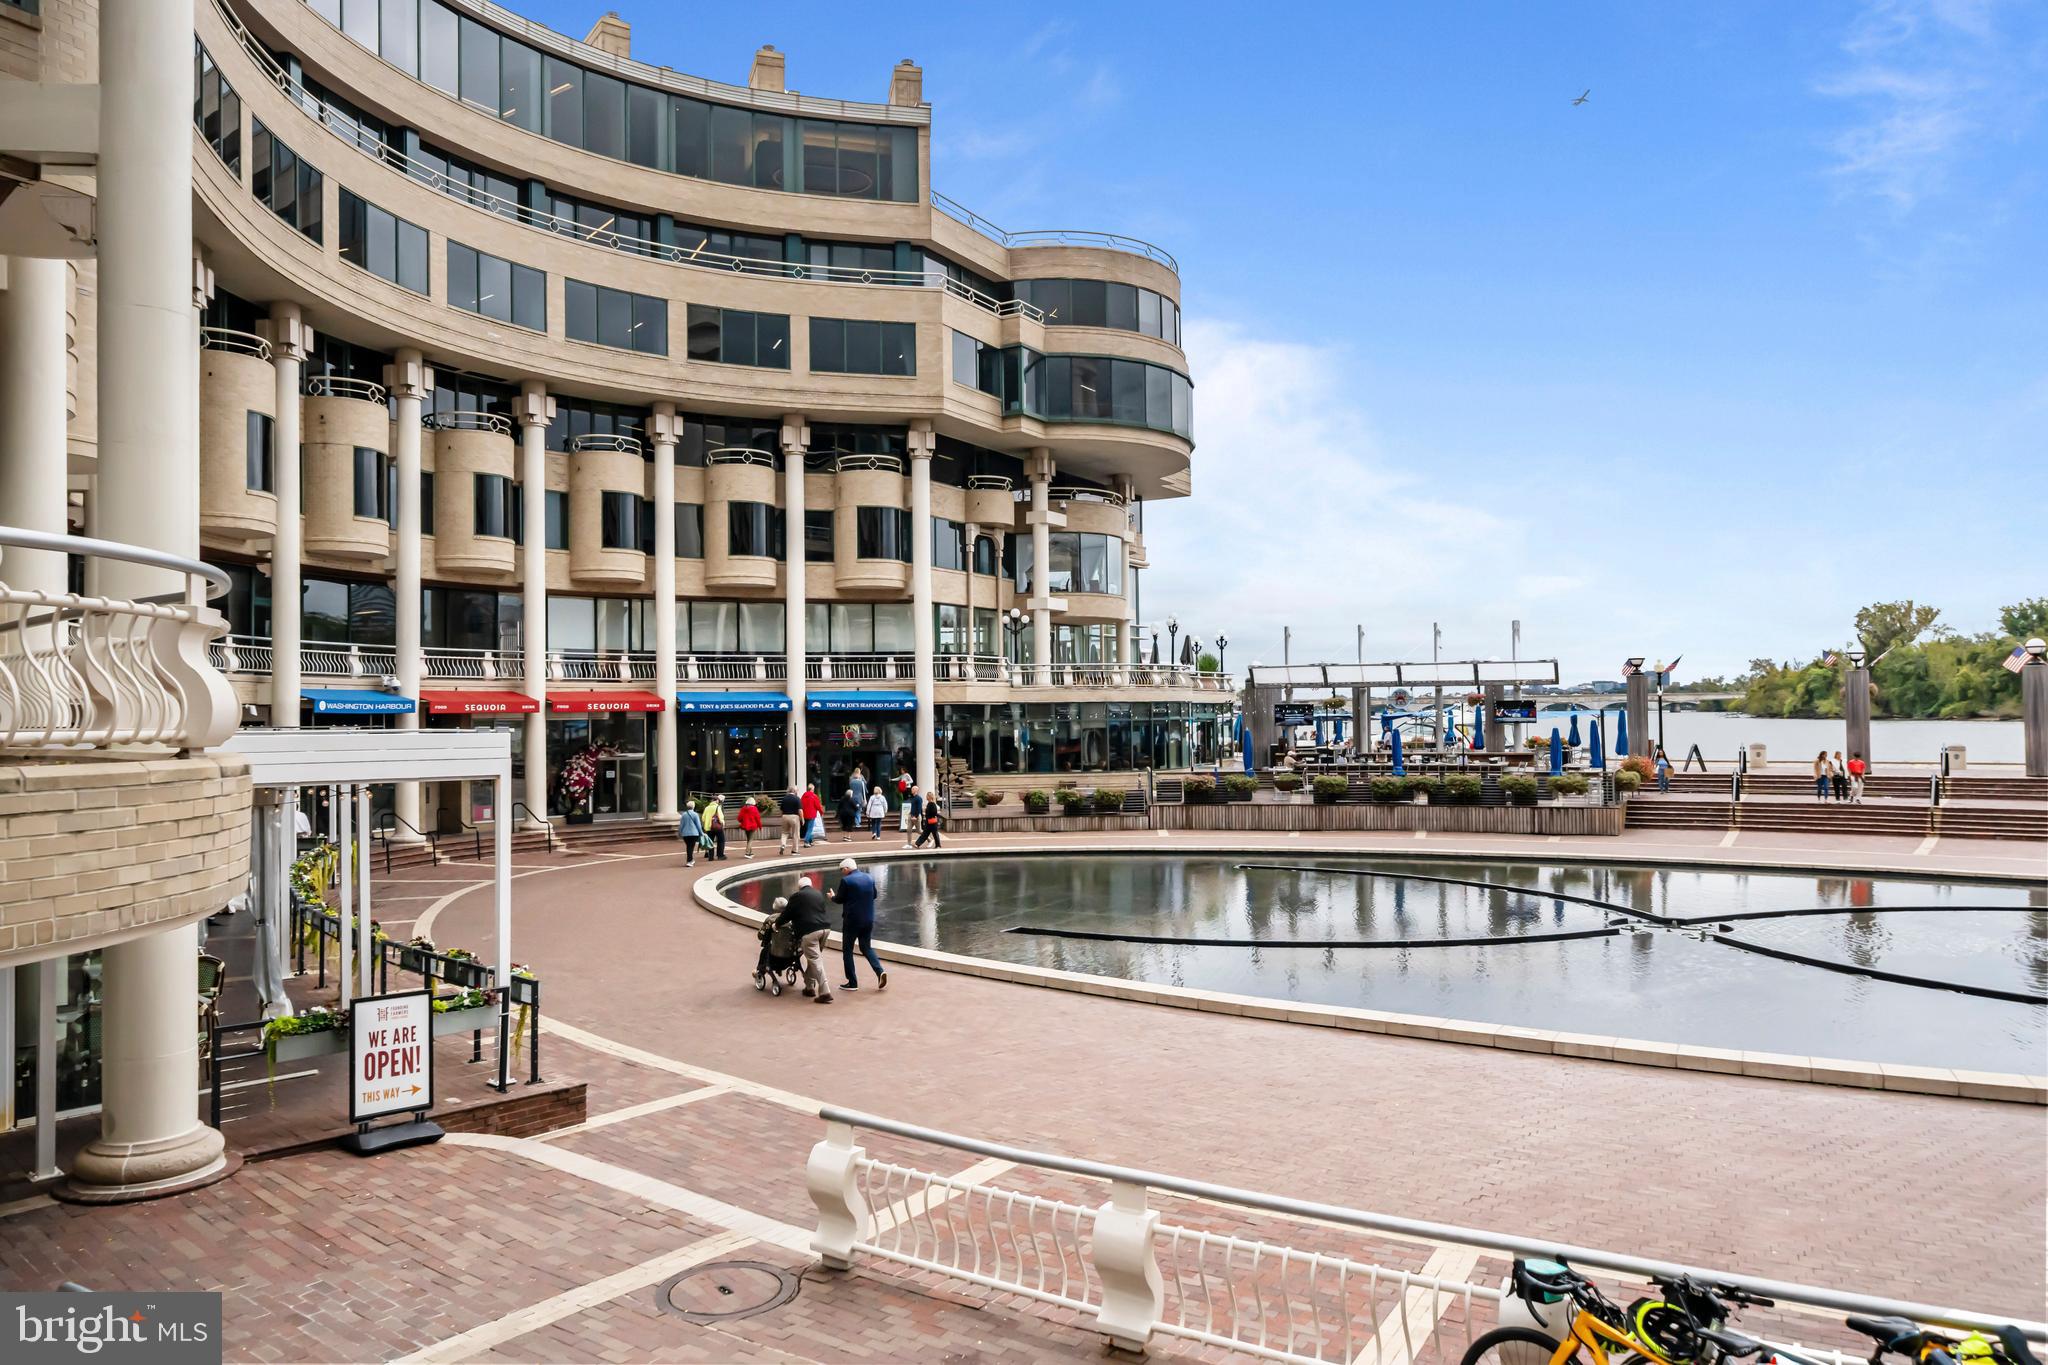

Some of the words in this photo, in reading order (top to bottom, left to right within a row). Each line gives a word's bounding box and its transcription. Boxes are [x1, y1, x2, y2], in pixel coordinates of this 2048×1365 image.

[368, 1029, 387, 1048] WE
[393, 1025, 416, 1045] ARE
[364, 1045, 421, 1081] OPEN!
[362, 1089, 381, 1103] THIS
[383, 1087, 400, 1101] WAY
